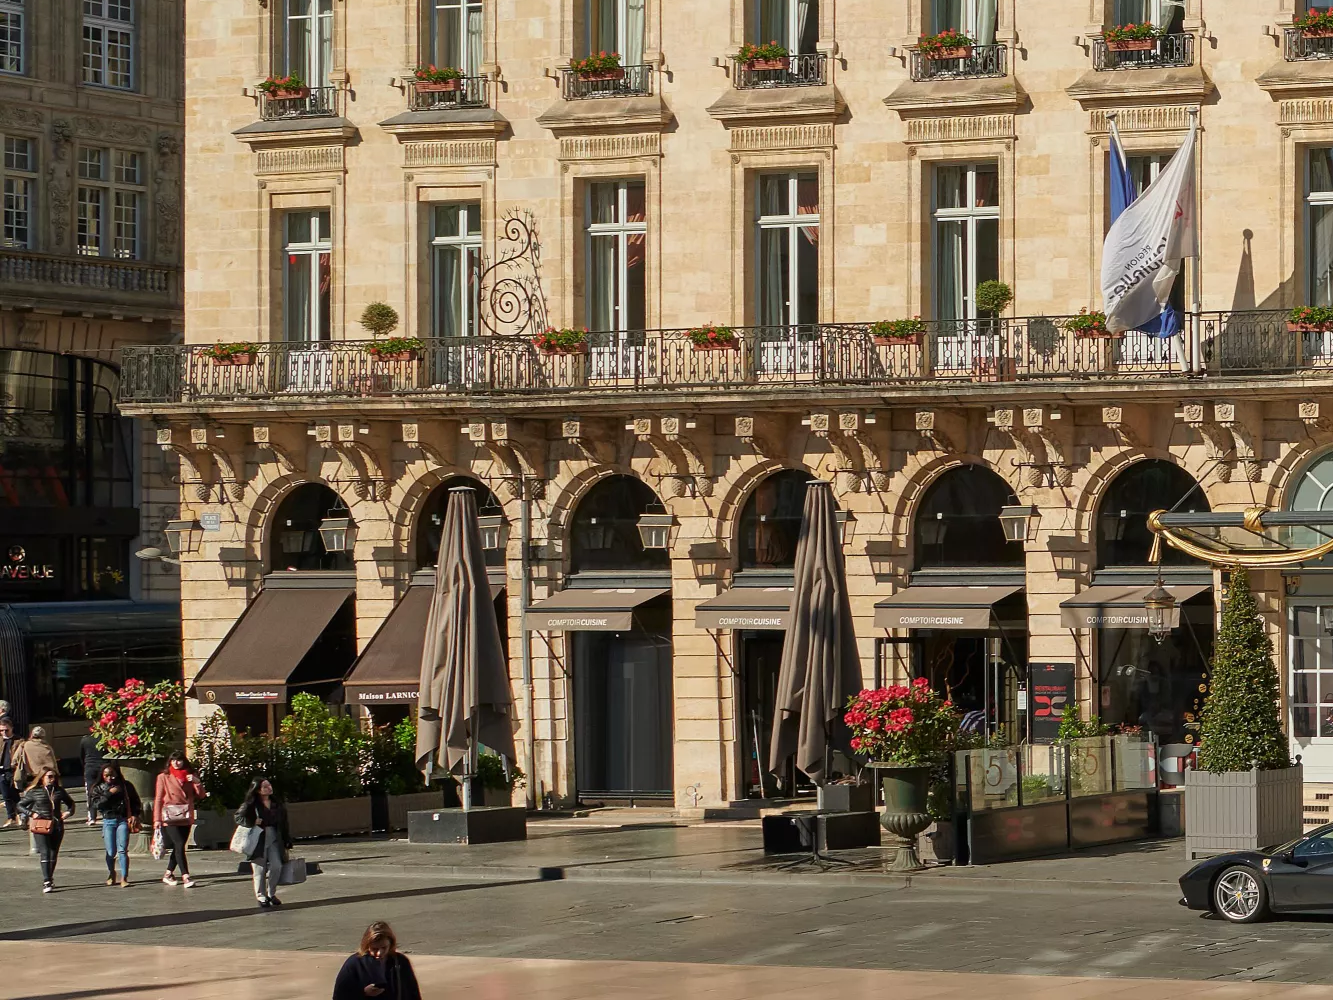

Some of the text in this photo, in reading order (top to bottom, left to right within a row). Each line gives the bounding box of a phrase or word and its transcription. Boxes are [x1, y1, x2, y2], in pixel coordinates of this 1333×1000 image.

[1, 564, 54, 579] AVENUE
[899, 616, 964, 625] COMPTOIRCUISINE
[358, 692, 384, 700] Maison
